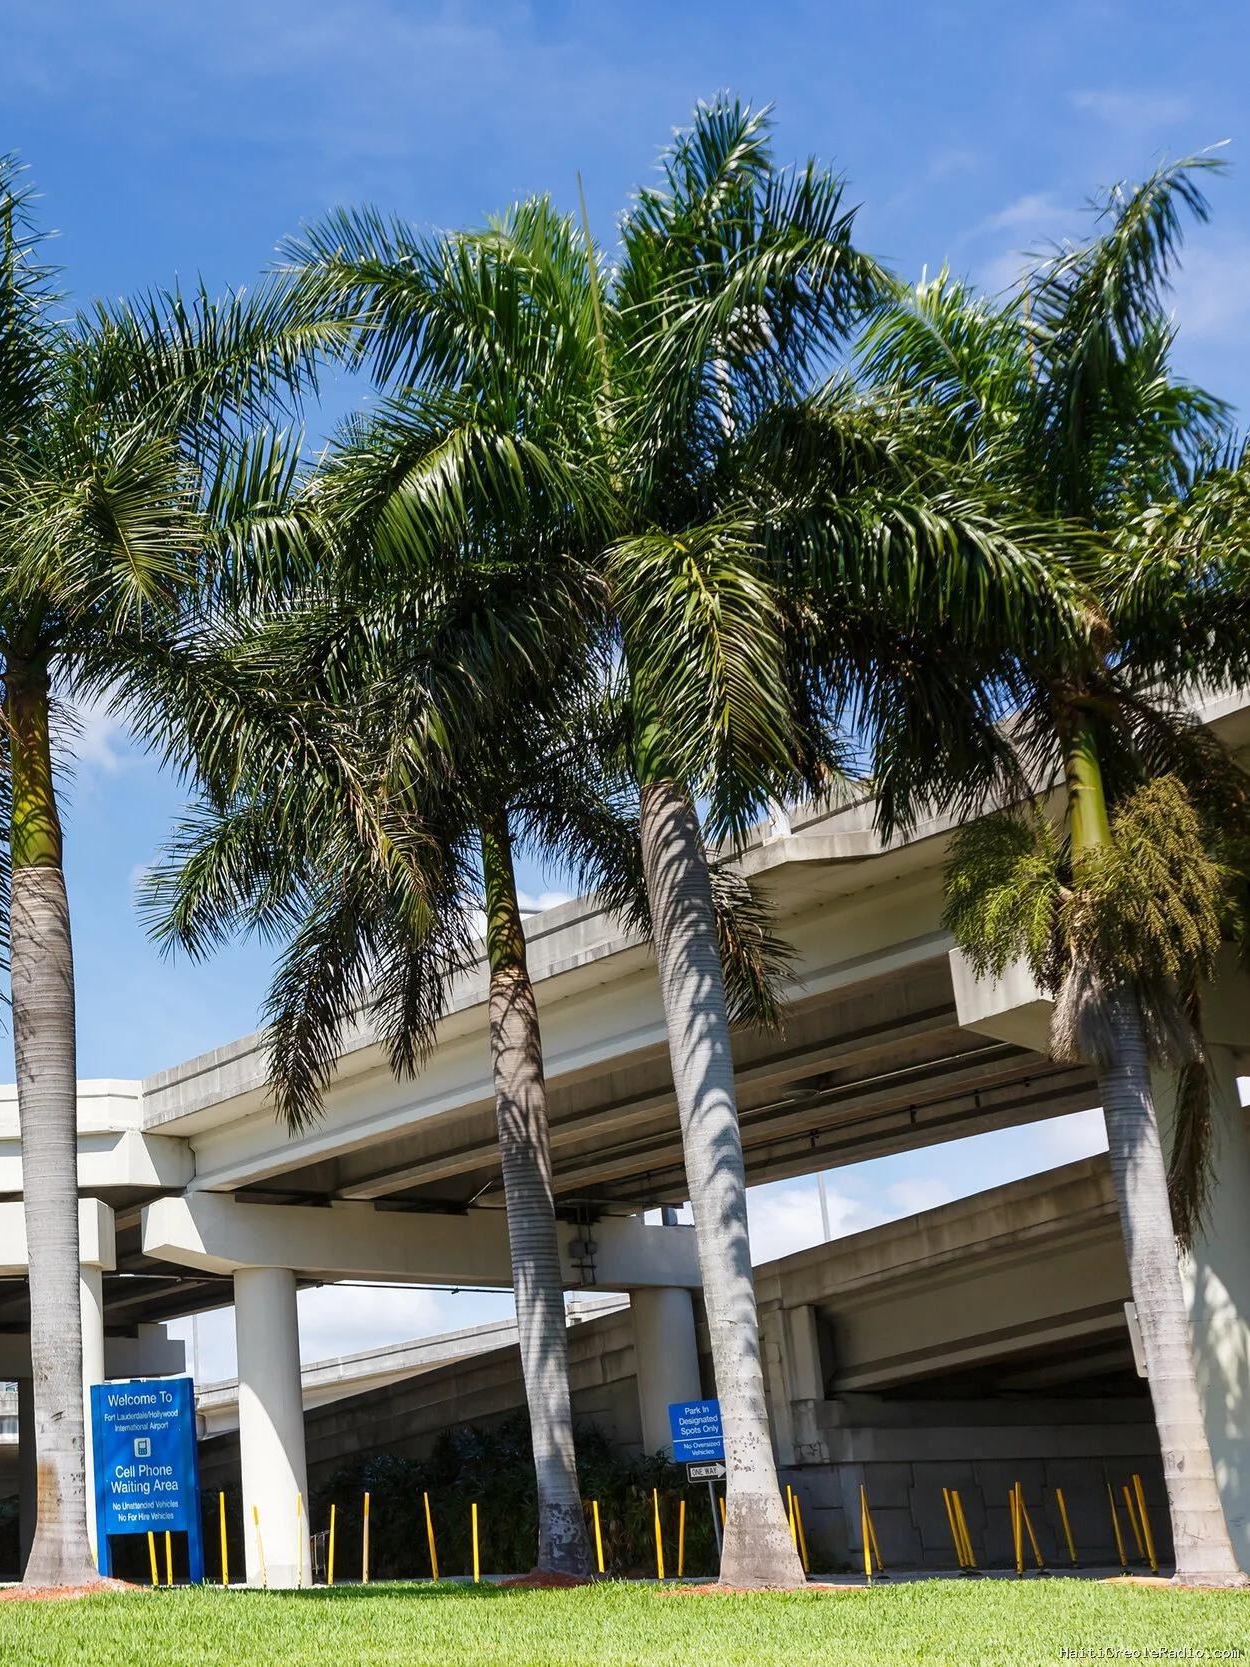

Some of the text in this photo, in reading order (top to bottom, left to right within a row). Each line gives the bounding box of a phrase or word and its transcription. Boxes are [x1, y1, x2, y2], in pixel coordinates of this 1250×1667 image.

[108, 1390, 173, 1407] Welcome To
[684, 1407, 701, 1415] Park
[104, 1413, 116, 1421] Fort
[678, 1415, 718, 1426] Designated
[114, 1421, 169, 1432] International Airport
[680, 1424, 719, 1436] Spots Only
[693, 1440, 721, 1449] Oversized
[115, 1464, 173, 1478] Cell Phone
[691, 1466, 717, 1476] ONE WAY
[110, 1479, 179, 1495] Waiting Area
[112, 1500, 179, 1511] No Unattended Vehicles
[118, 1512, 174, 1521] No For Hire Vehicles
